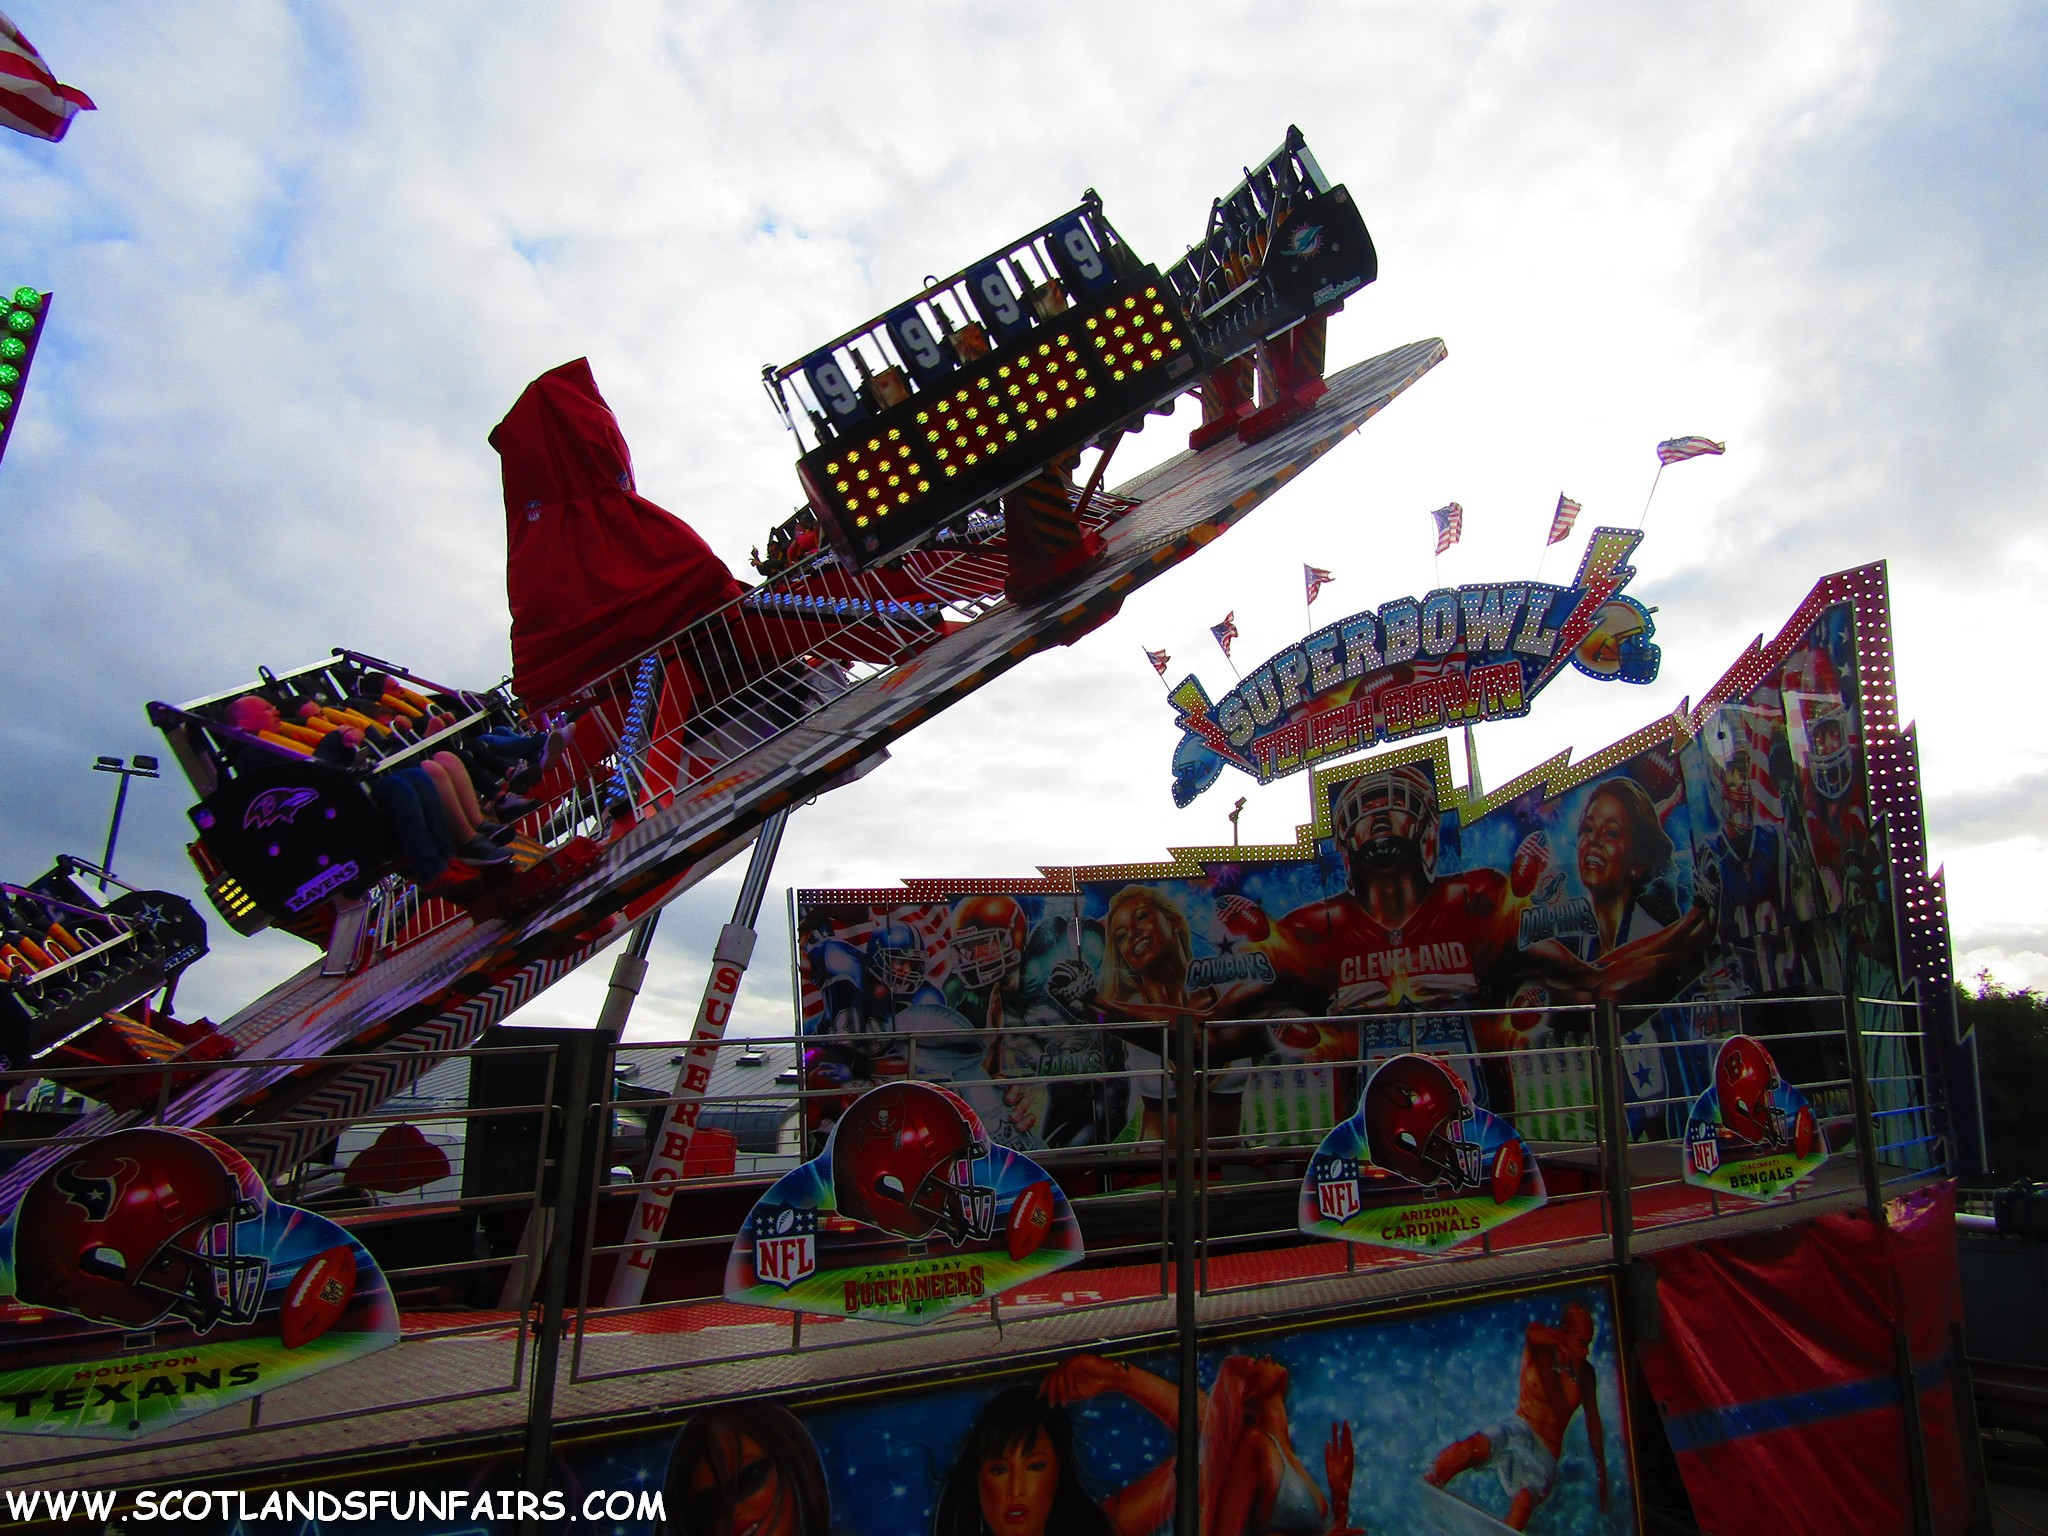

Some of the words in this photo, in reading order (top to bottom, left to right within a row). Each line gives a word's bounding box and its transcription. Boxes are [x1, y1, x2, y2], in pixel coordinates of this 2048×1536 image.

[1064, 228, 1103, 280] 9
[981, 273, 1020, 325] 9
[901, 317, 941, 369] 9
[815, 363, 857, 415] 9
[1218, 588, 1559, 747] SUPERBOWL
[1252, 697, 1376, 781] TOUCH
[1381, 661, 1526, 736] DOWN
[286, 860, 359, 912] RAVENS
[1519, 897, 1598, 949] DOLPHINS
[164, 943, 200, 973] OWBOYS
[1187, 952, 1275, 990] COWBOYS
[1340, 941, 1468, 983] CLEVELAND
[627, 967, 740, 1271] SUPERBOWL
[1694, 1140, 1719, 1170] NFL
[1730, 1167, 1794, 1189] BENGALS
[1319, 1182, 1360, 1217] NFL
[1400, 1206, 1460, 1222] ARIZONA
[1381, 1216, 1481, 1240] CARDINALS
[758, 1236, 814, 1282] NFL
[865, 1266, 920, 1280] TAMPA
[932, 1262, 963, 1272] BAY
[844, 1266, 984, 1313] BUCCANEERS
[0, 1363, 261, 1418] TEXANS
[74, 1356, 198, 1380] HOUSTON
